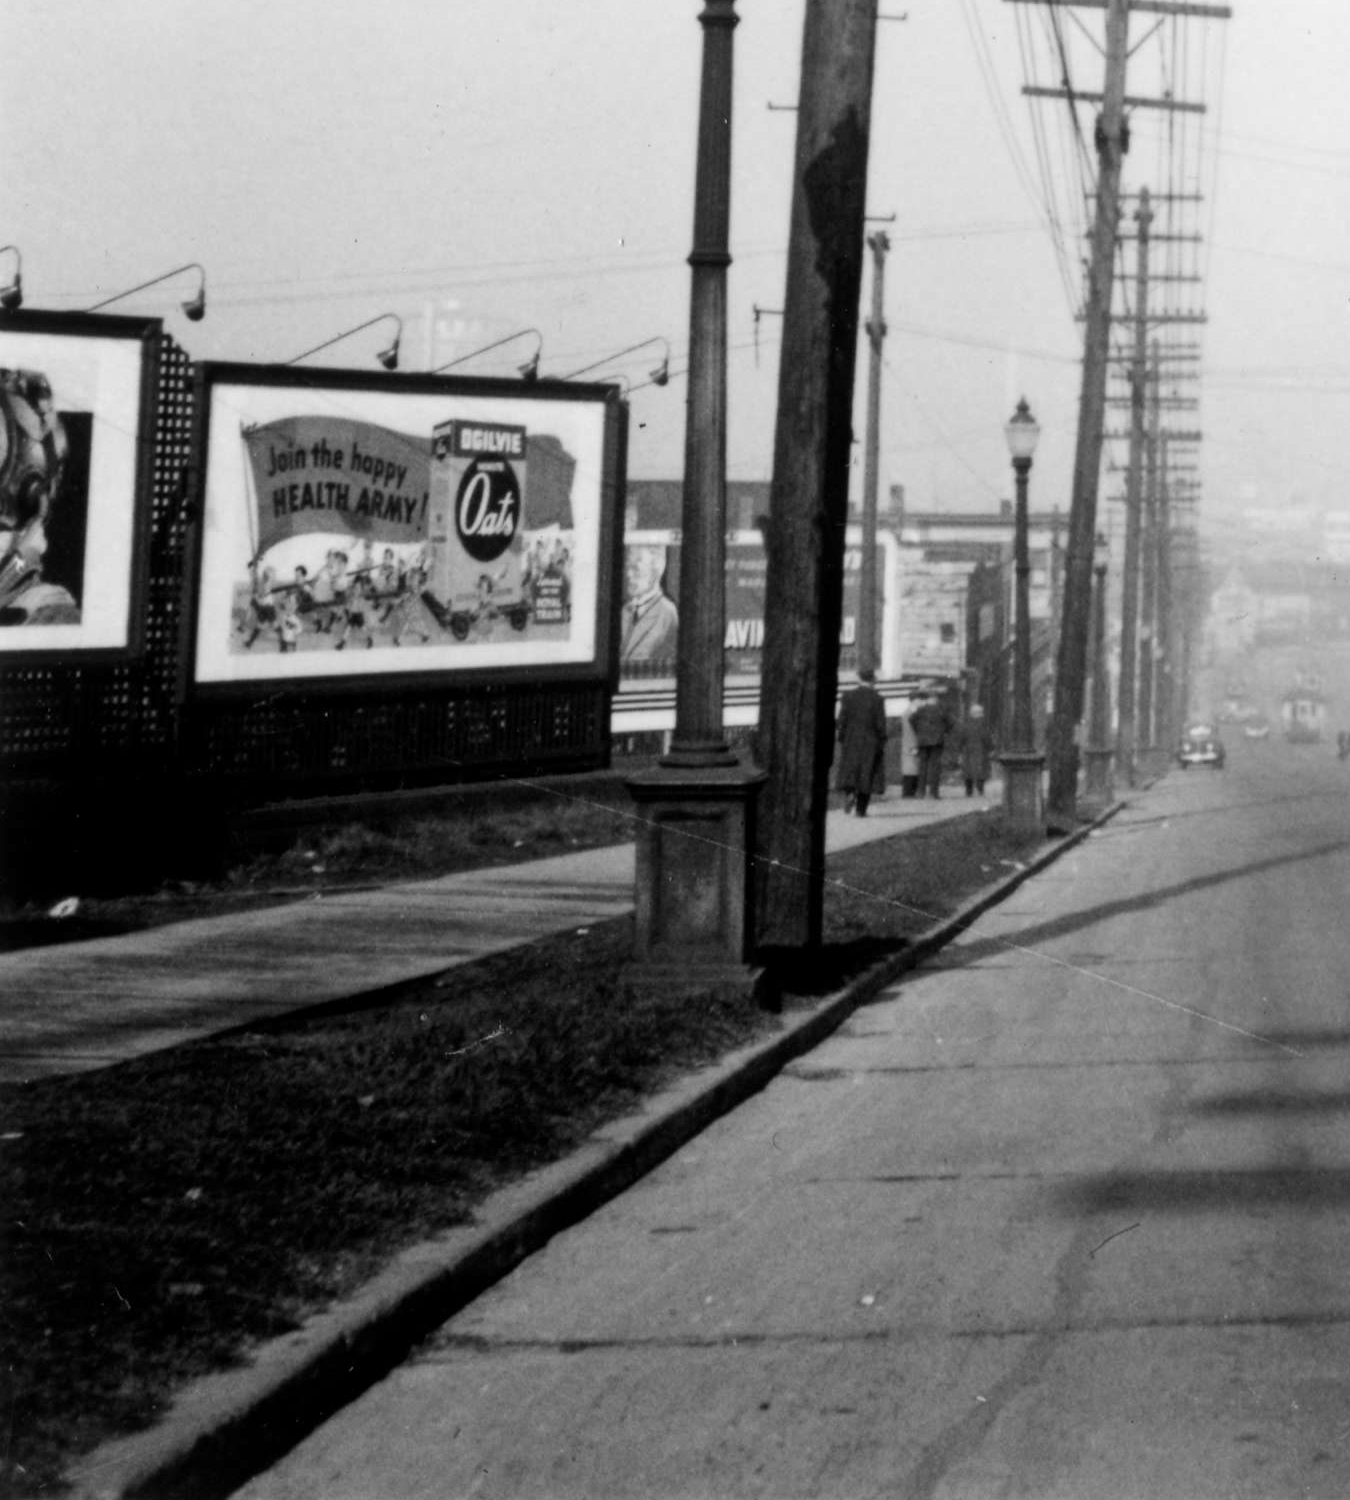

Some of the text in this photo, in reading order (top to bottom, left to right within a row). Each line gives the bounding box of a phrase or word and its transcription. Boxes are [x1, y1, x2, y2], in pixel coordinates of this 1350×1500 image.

[267, 437, 408, 490] Join the happy
[460, 428, 522, 454] OGILVIE
[272, 481, 430, 532] HEALTH ARMY!
[460, 472, 515, 536] Oats
